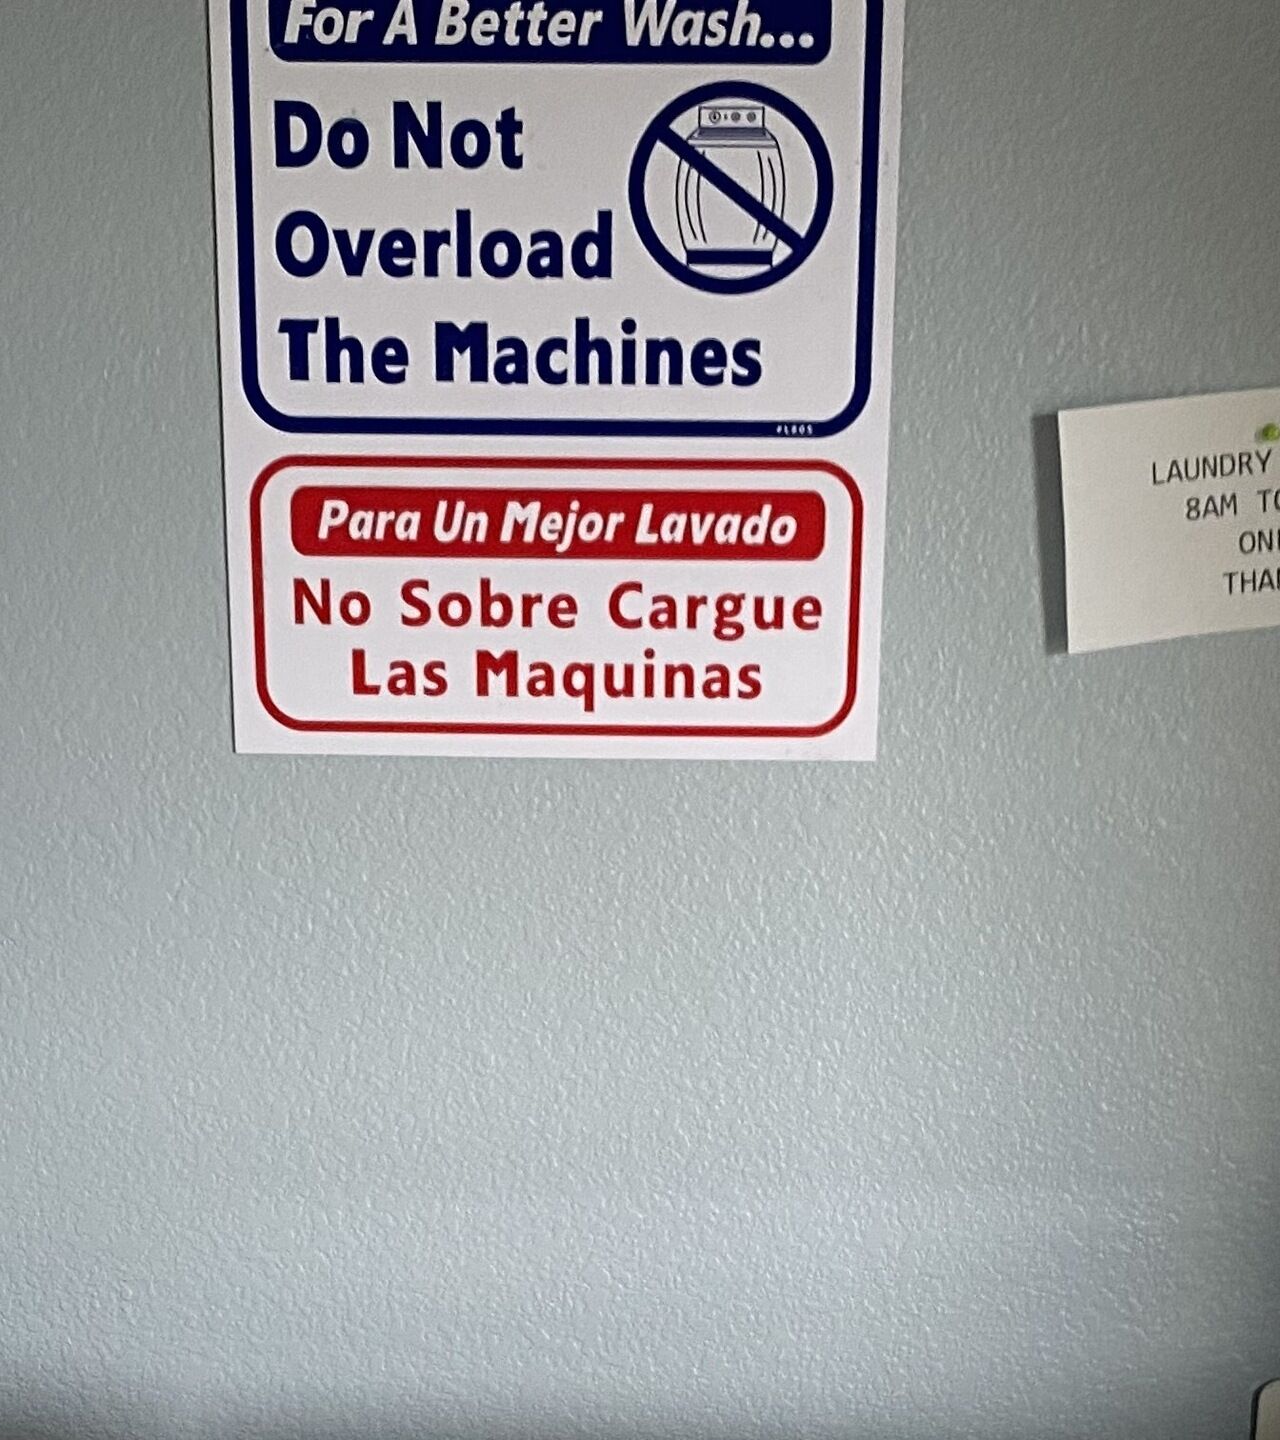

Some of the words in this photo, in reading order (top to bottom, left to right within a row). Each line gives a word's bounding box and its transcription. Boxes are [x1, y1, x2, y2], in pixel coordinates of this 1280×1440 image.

[284, 0, 375, 44] For
[382, 0, 417, 45] A
[435, 0, 603, 46] Better
[623, 0, 814, 48] Wash...
[274, 101, 369, 168] Do
[392, 101, 523, 169] Not
[274, 209, 614, 279] Overload
[279, 317, 409, 384] The
[434, 317, 762, 387] Machines
[1151, 449, 1272, 486] LAUNDRY
[317, 499, 419, 542] Para
[433, 503, 487, 543] Un
[498, 503, 624, 554] Mejor
[635, 503, 798, 546] Lavado
[1186, 494, 1238, 521] 8AM
[292, 577, 372, 626] No
[400, 579, 578, 629] Sobre
[608, 581, 822, 641] Cargue
[351, 649, 447, 696] Las
[476, 649, 762, 712] Maquinas
